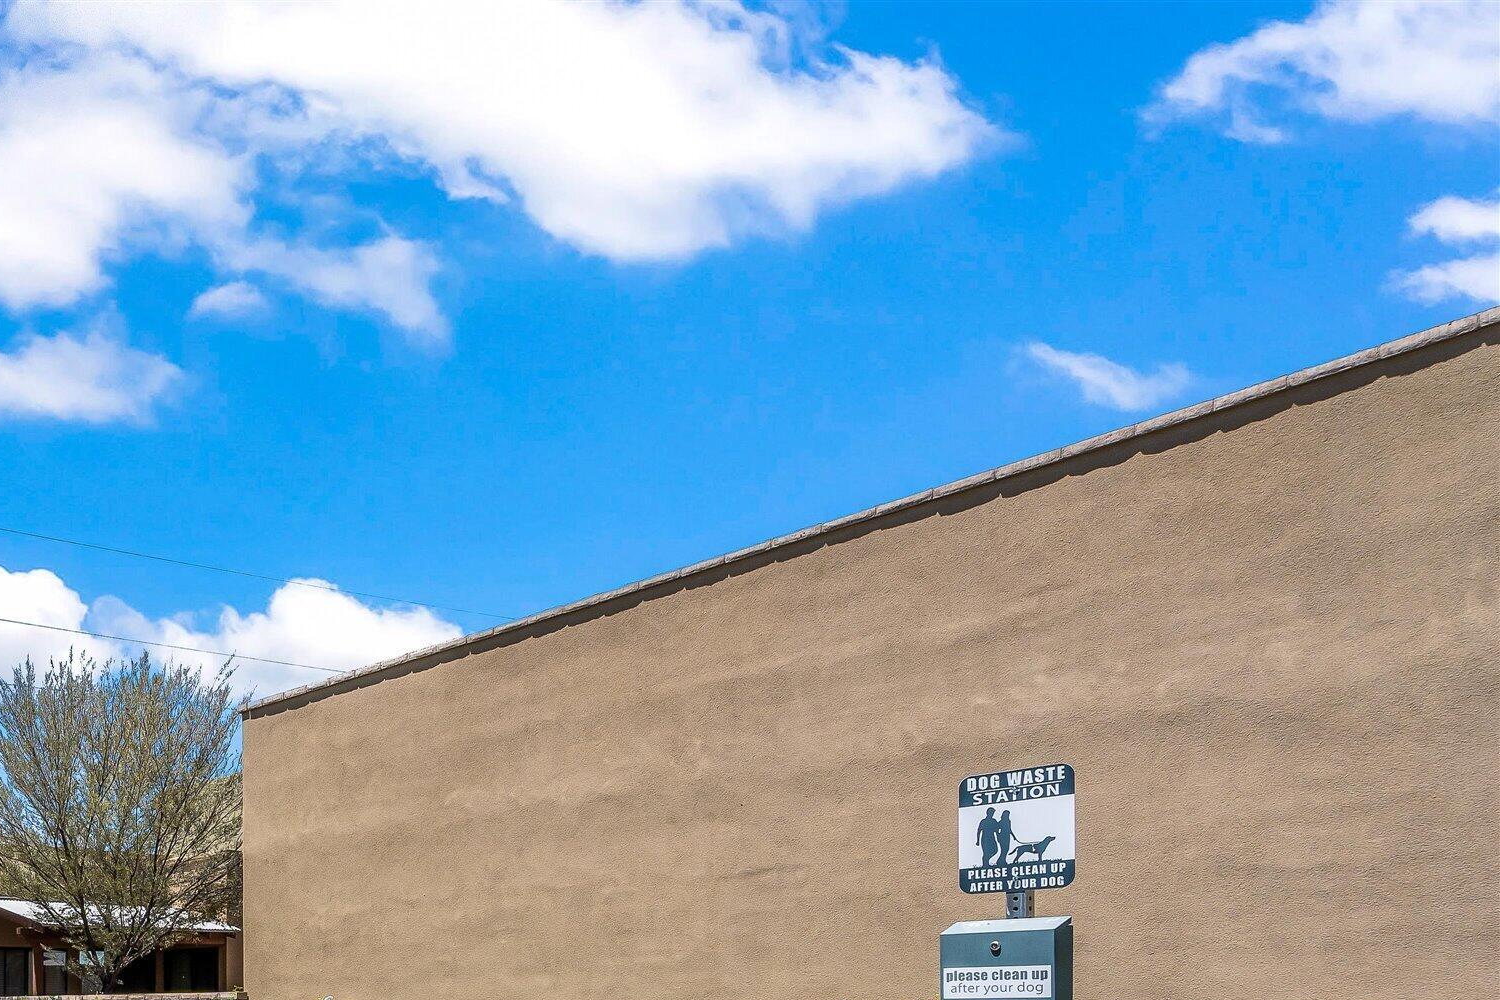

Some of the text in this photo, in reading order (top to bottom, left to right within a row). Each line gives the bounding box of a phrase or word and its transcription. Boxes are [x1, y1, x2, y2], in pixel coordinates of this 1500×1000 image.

[966, 766, 1065, 792] DOG WASTE
[972, 784, 1060, 805] STATION
[968, 862, 1067, 880] PLEASE CLEAN UP
[969, 876, 1065, 892] AFTER YOUR DOG
[946, 968, 1049, 983] please clean up
[950, 982, 1044, 995] after your dog
